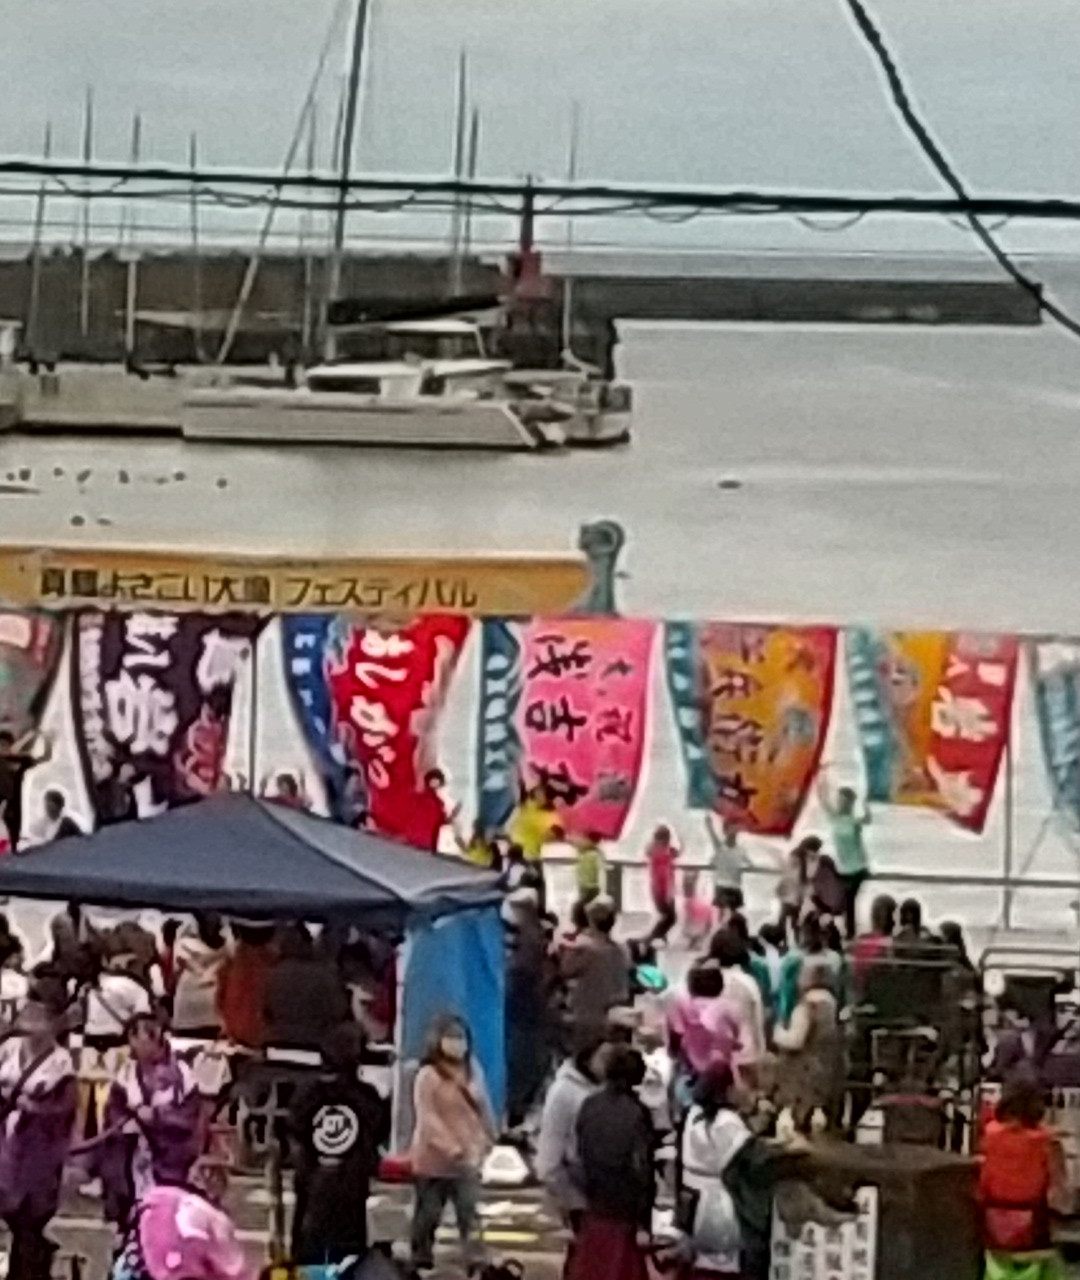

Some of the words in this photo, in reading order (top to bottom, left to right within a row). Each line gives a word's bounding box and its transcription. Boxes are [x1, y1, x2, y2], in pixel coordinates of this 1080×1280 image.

[40, 567, 271, 605] よさこい大
